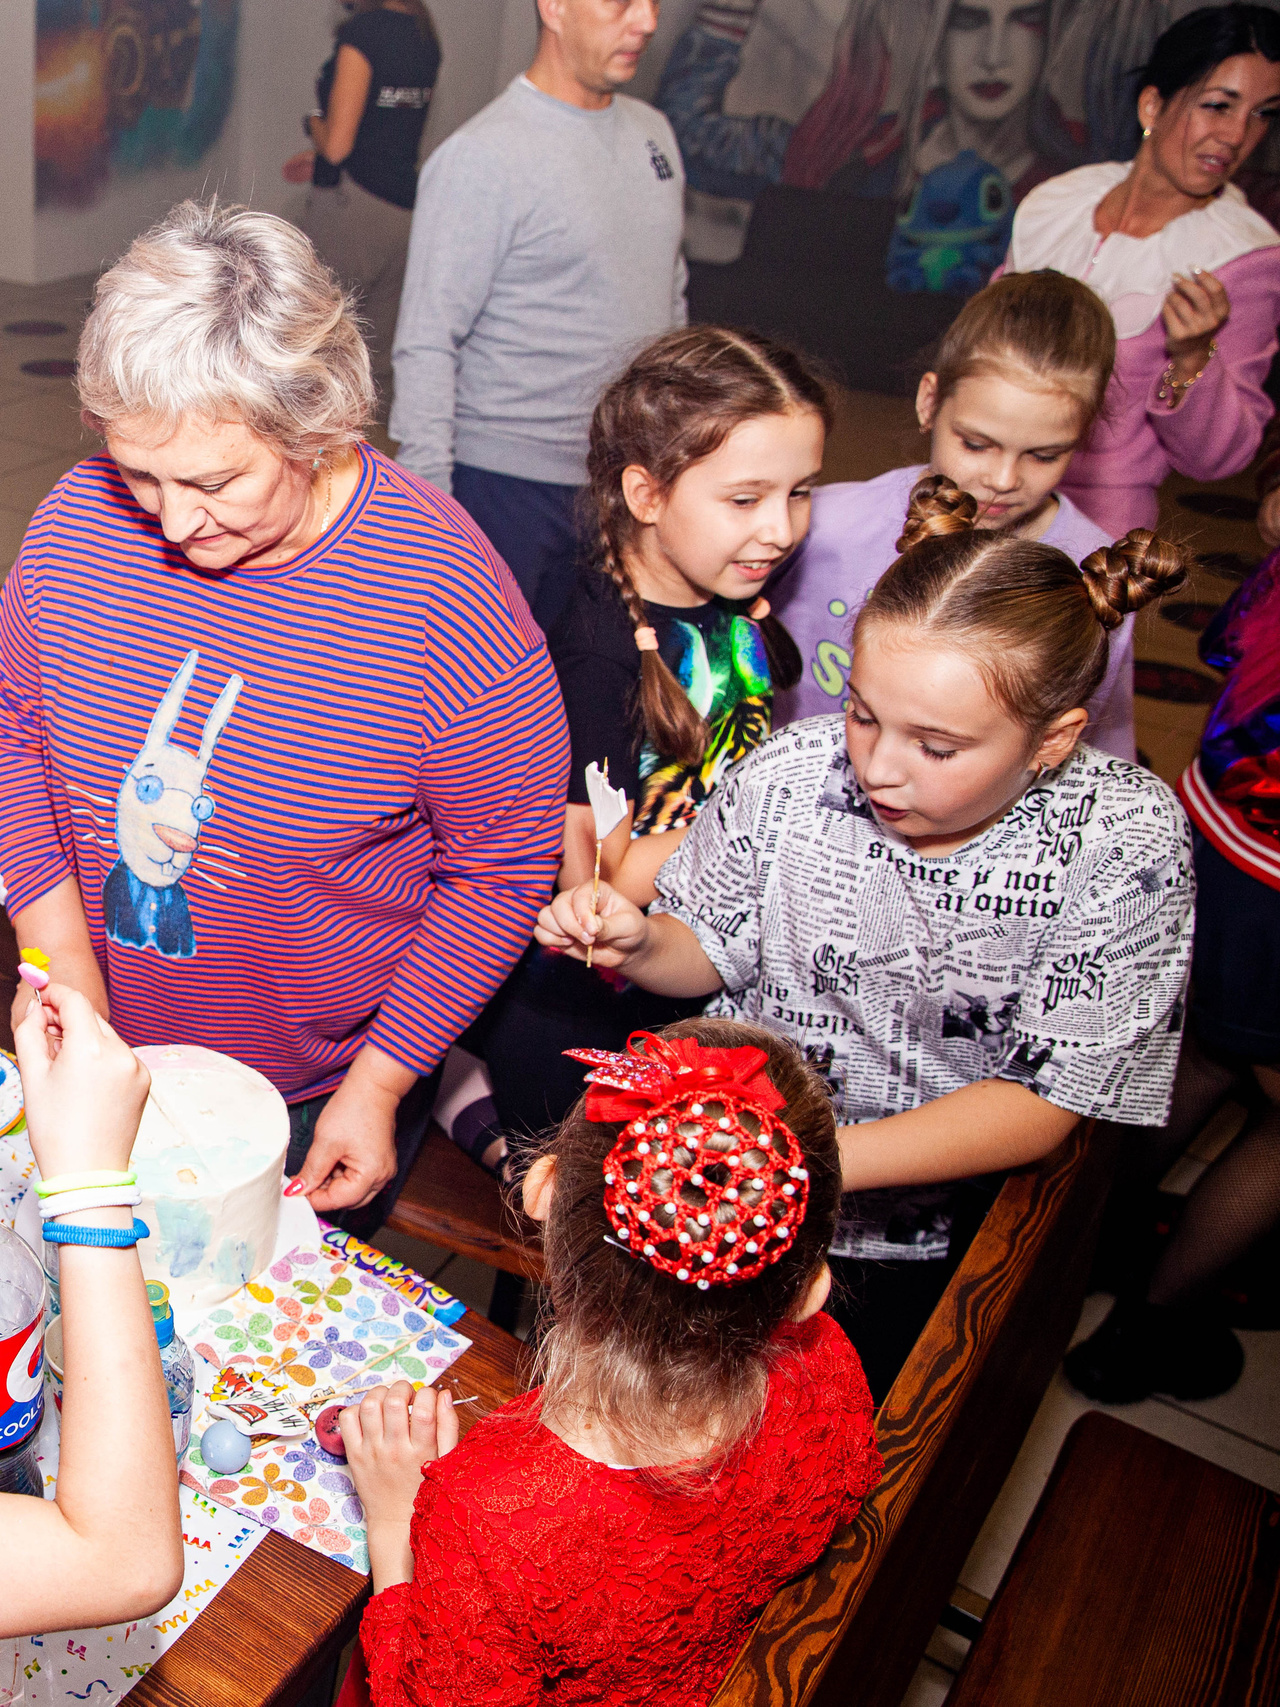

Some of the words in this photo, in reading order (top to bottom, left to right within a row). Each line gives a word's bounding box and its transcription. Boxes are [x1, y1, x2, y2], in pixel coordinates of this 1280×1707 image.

[866, 841, 961, 887] sience
[1004, 869, 1057, 893] not
[974, 893, 1065, 920] optio
[1133, 998, 1151, 1020] fun
